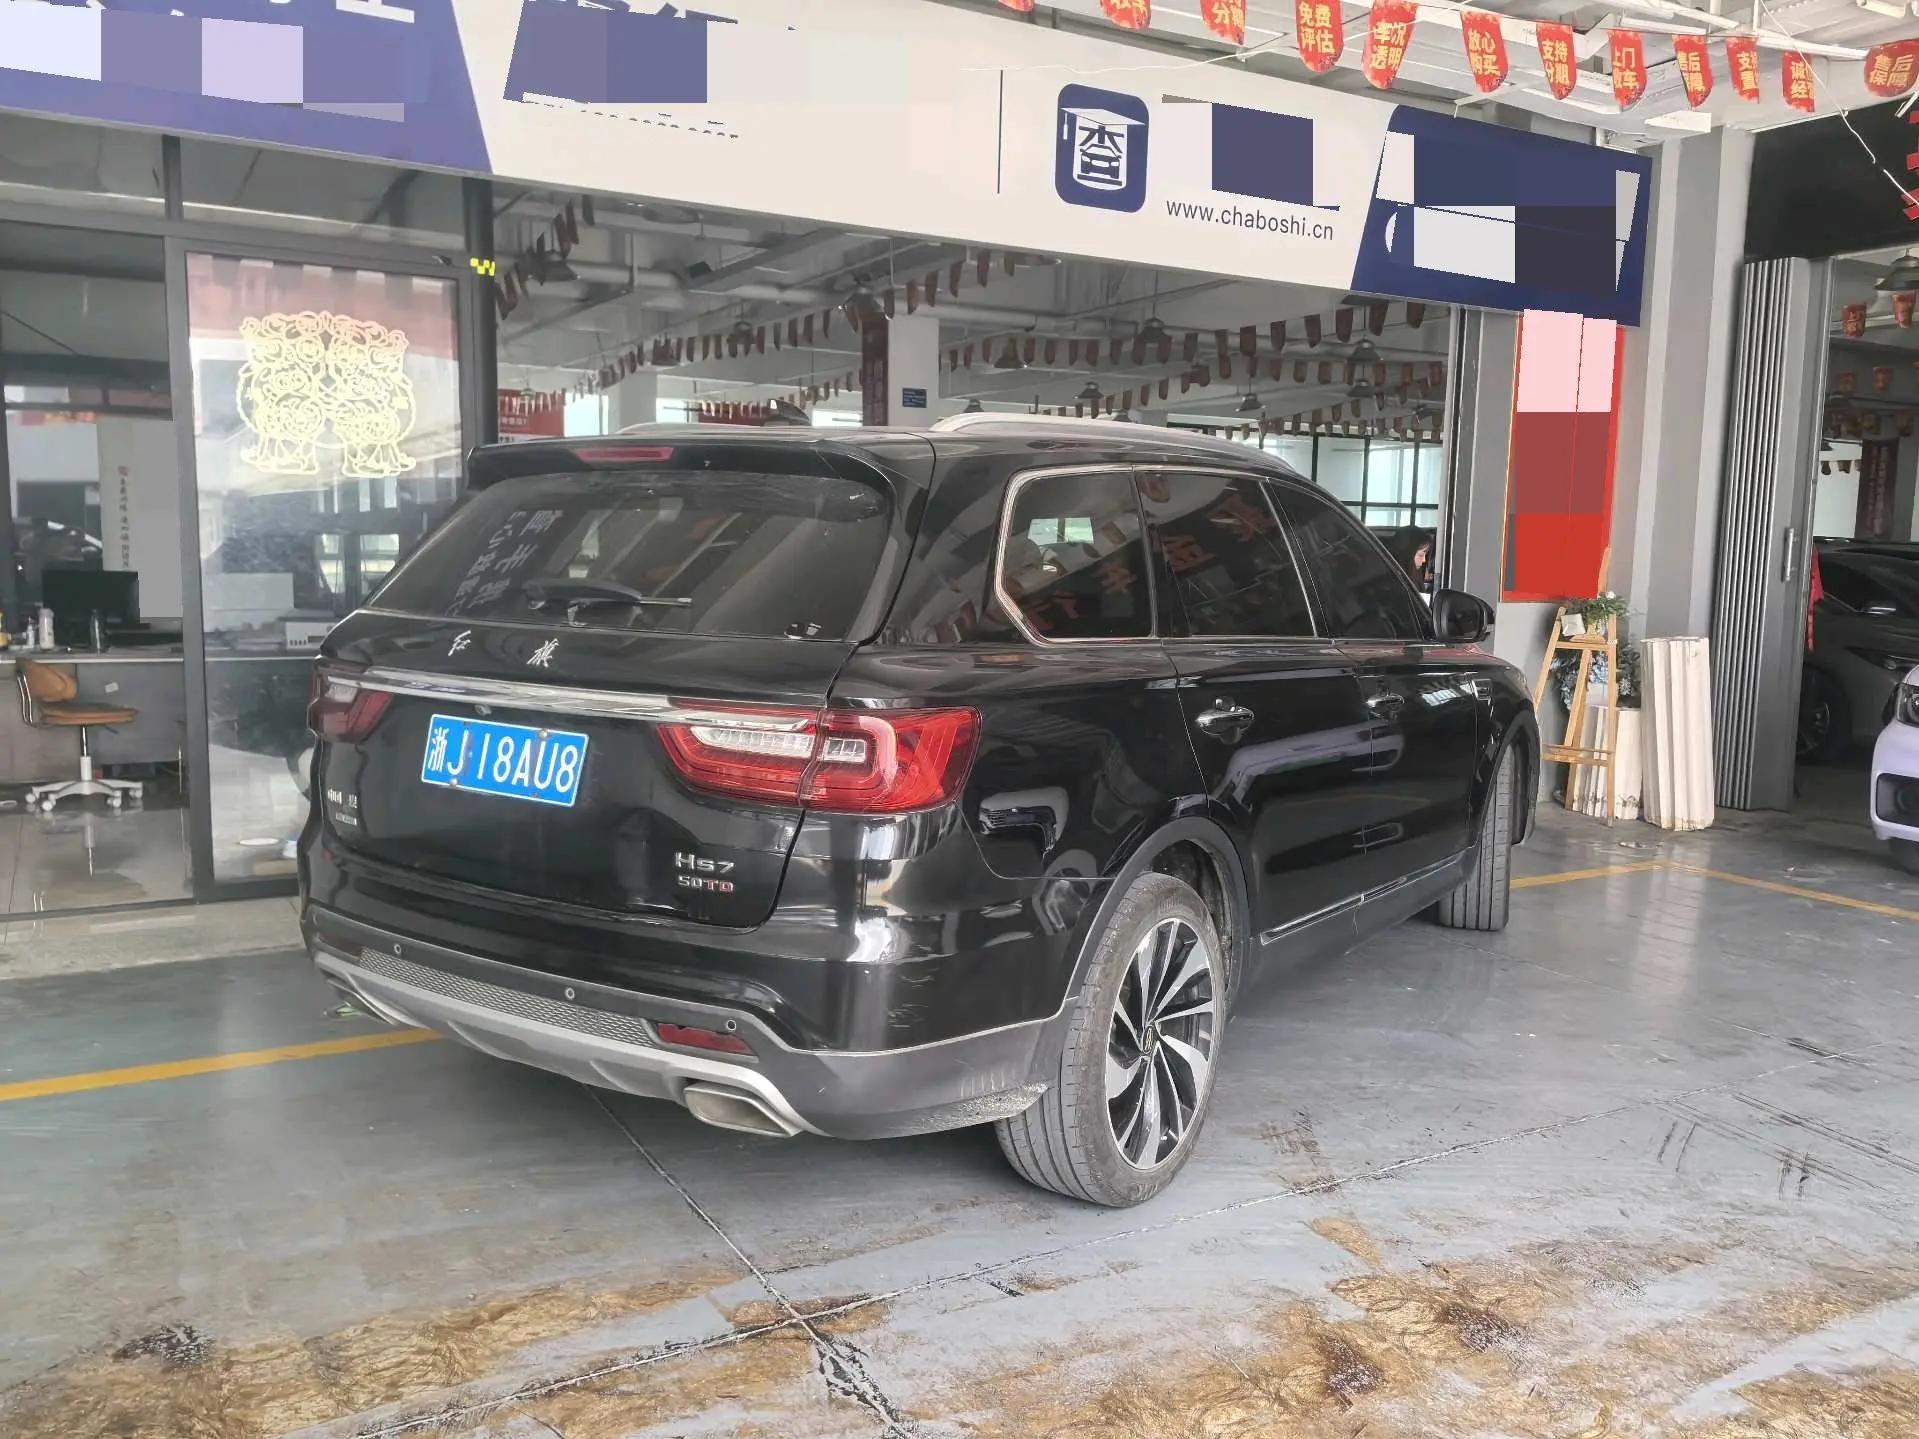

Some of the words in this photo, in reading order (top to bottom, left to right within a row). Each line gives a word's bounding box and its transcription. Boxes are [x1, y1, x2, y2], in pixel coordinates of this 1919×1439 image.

[1298, 2, 1332, 28] 免费
[1301, 27, 1336, 54] 评估
[1468, 28, 1496, 51] 放心
[1542, 39, 1568, 62] 支持
[1370, 45, 1403, 70] 透明
[1470, 53, 1499, 76] 购买
[1612, 47, 1636, 68] 上门
[1873, 54, 1914, 74] 售后
[1869, 70, 1908, 88] 保障
[1166, 200, 1334, 241] www.chaboshi.cn
[675, 851, 735, 874] HS7
